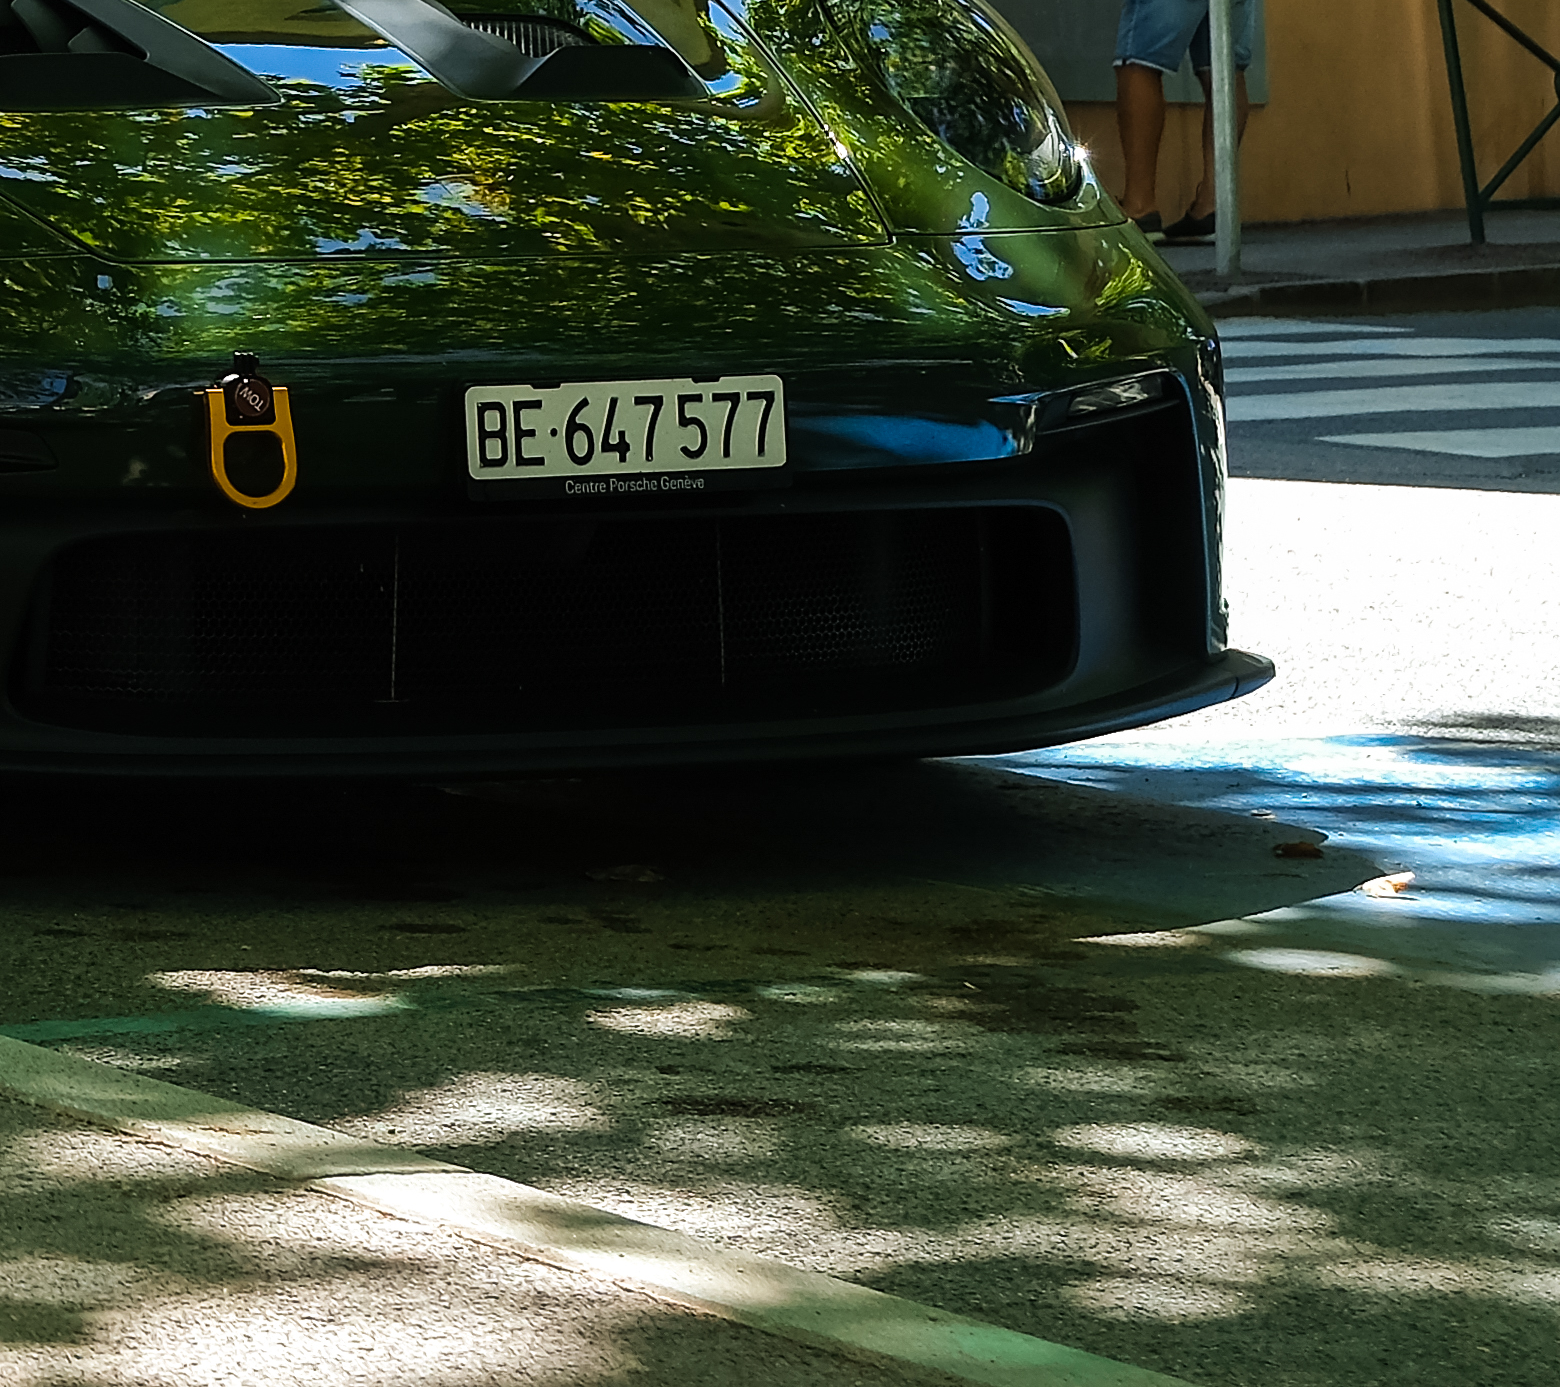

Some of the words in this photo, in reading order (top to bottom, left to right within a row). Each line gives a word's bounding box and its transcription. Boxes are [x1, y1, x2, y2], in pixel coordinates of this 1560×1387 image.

[239, 386, 264, 412] TOW
[565, 480, 607, 494] Centre
[610, 477, 658, 492] Porsche
